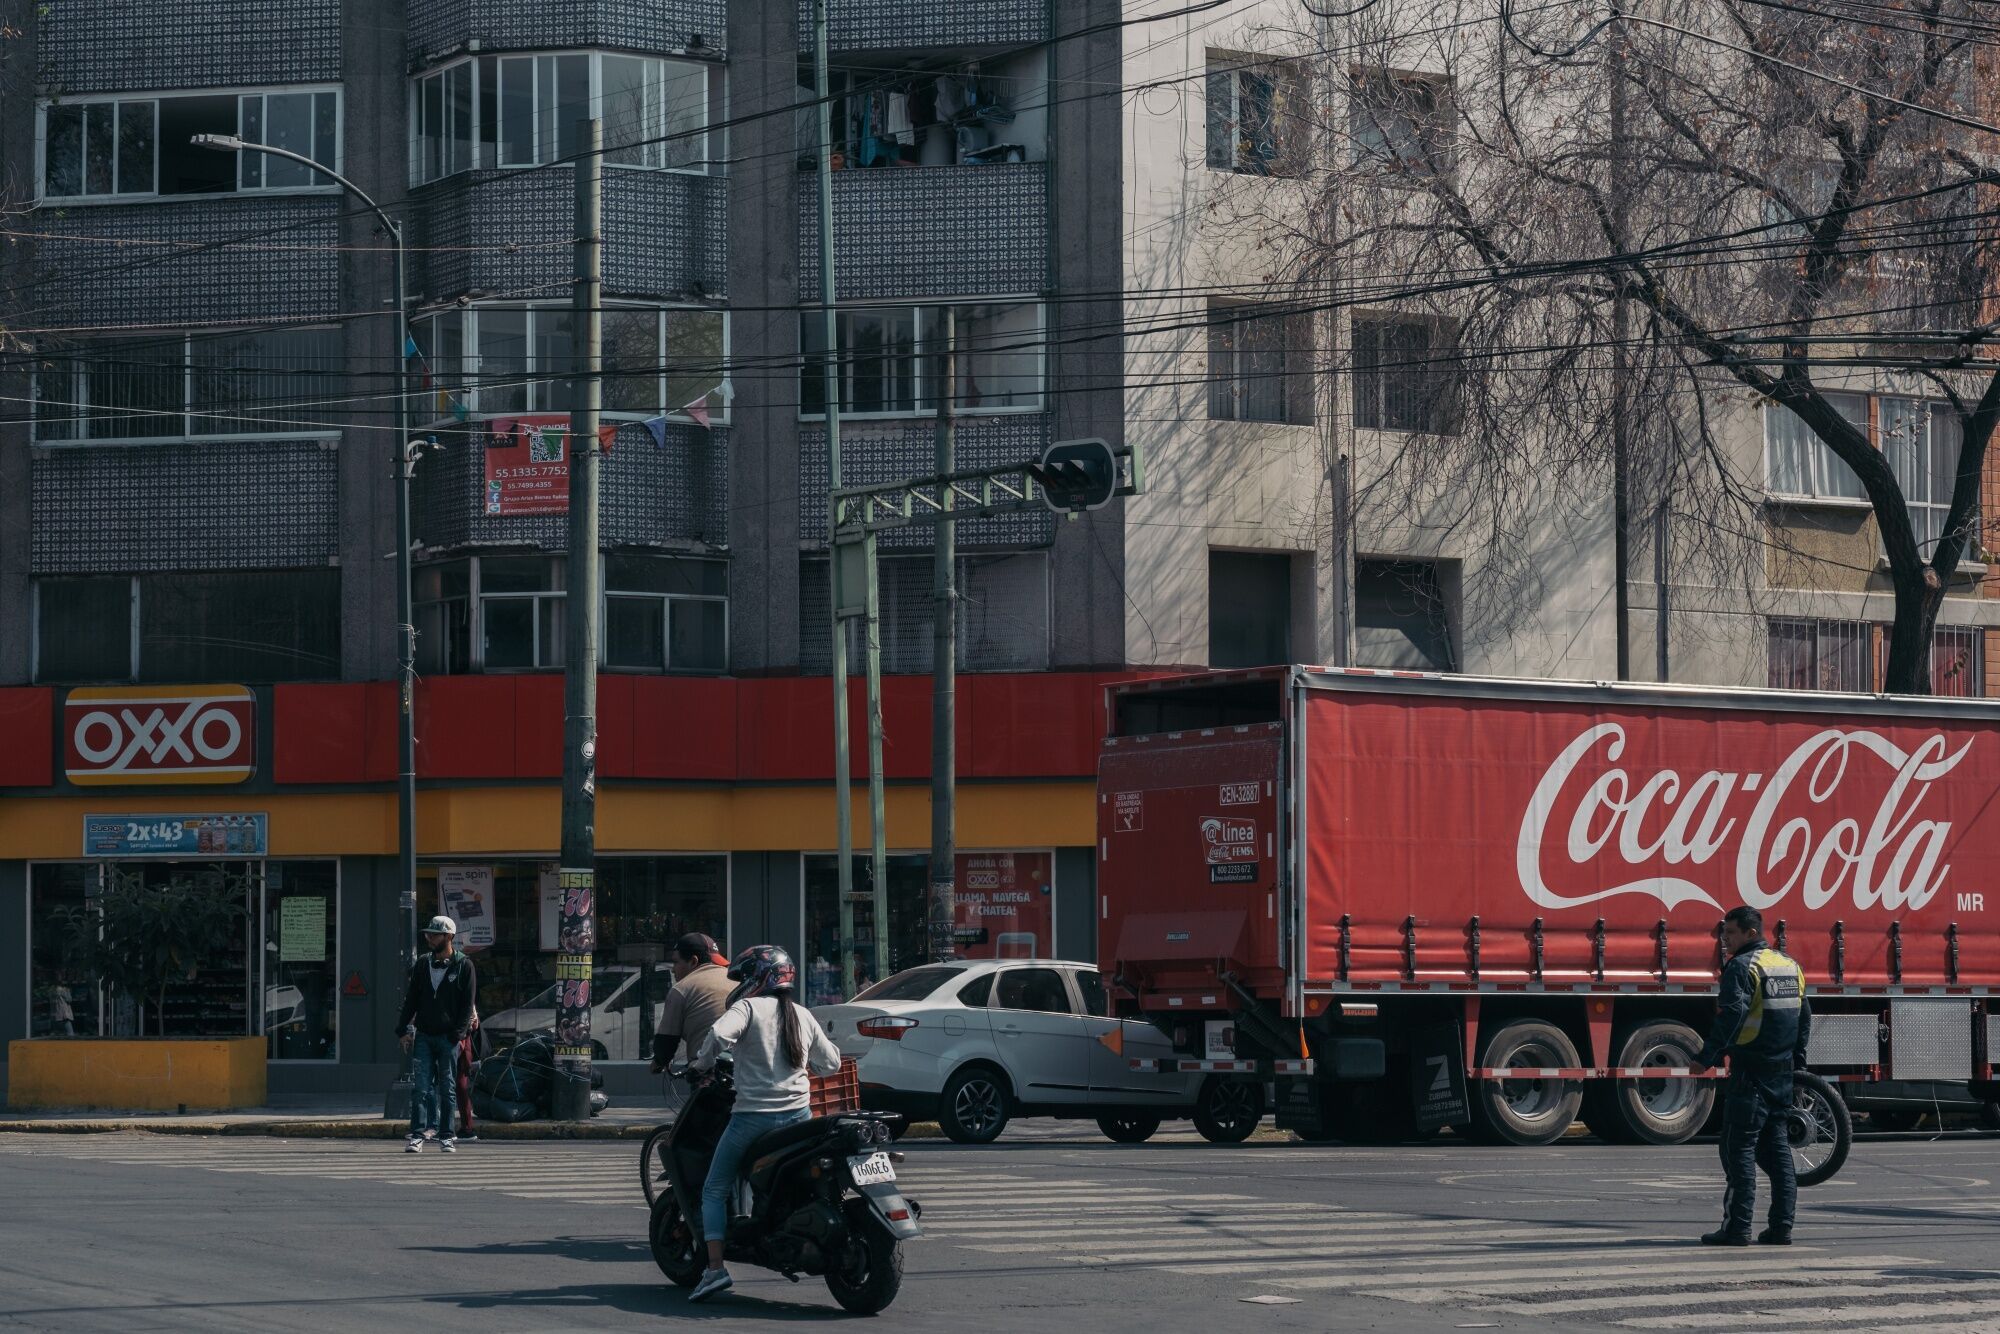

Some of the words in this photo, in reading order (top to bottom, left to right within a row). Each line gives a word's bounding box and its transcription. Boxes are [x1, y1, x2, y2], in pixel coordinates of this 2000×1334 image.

[495, 466, 568, 478] 55.1335.7752
[507, 481, 552, 489] 55.7499.4355
[74, 706, 242, 766] OXXO
[1516, 722, 1976, 912] Coca-Cola
[968, 860, 996, 868] AHORA
[999, 859, 1014, 868] CON
[465, 869, 488, 881] spin
[969, 874, 998, 886] OXXO
[993, 893, 1031, 903] NAVEGA
[1957, 894, 1984, 912] MR
[969, 906, 975, 915] Y
[978, 906, 1017, 915] CHATEA!
